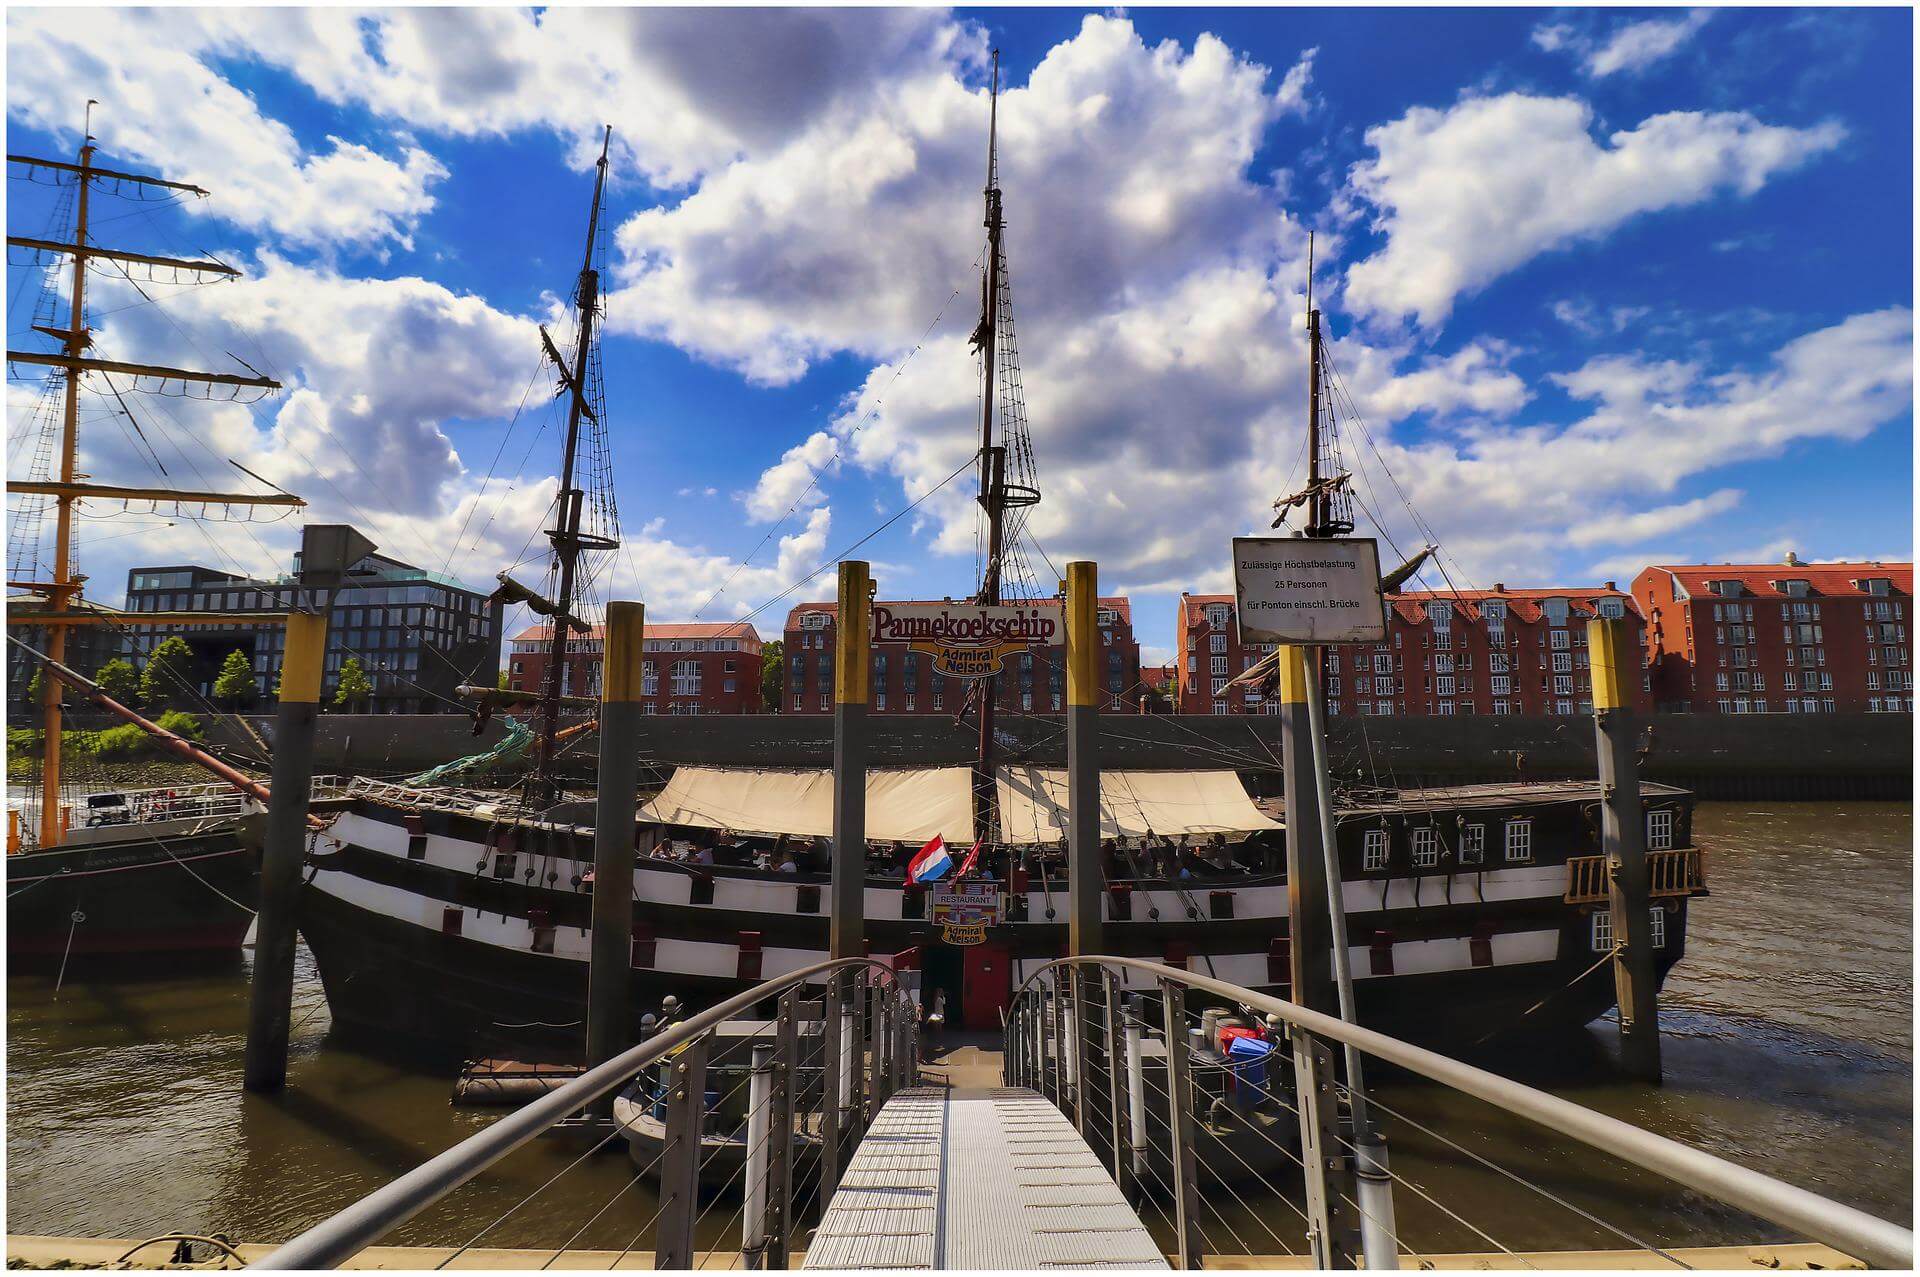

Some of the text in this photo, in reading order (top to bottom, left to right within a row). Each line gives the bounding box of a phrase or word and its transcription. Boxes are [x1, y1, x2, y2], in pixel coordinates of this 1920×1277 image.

[1241, 560, 1356, 570] Zulässige Höchstbelastung
[1274, 580, 1328, 589] 25 Personen
[1247, 599, 1360, 610] für Ponton einschl. Brücke
[871, 606, 1056, 643] Pannekoekschip
[942, 648, 994, 662] Admiral
[946, 660, 992, 673] Nelson
[940, 896, 991, 904] RESTAURANT
[946, 926, 982, 936] Admiral
[949, 934, 980, 944] Nelson
